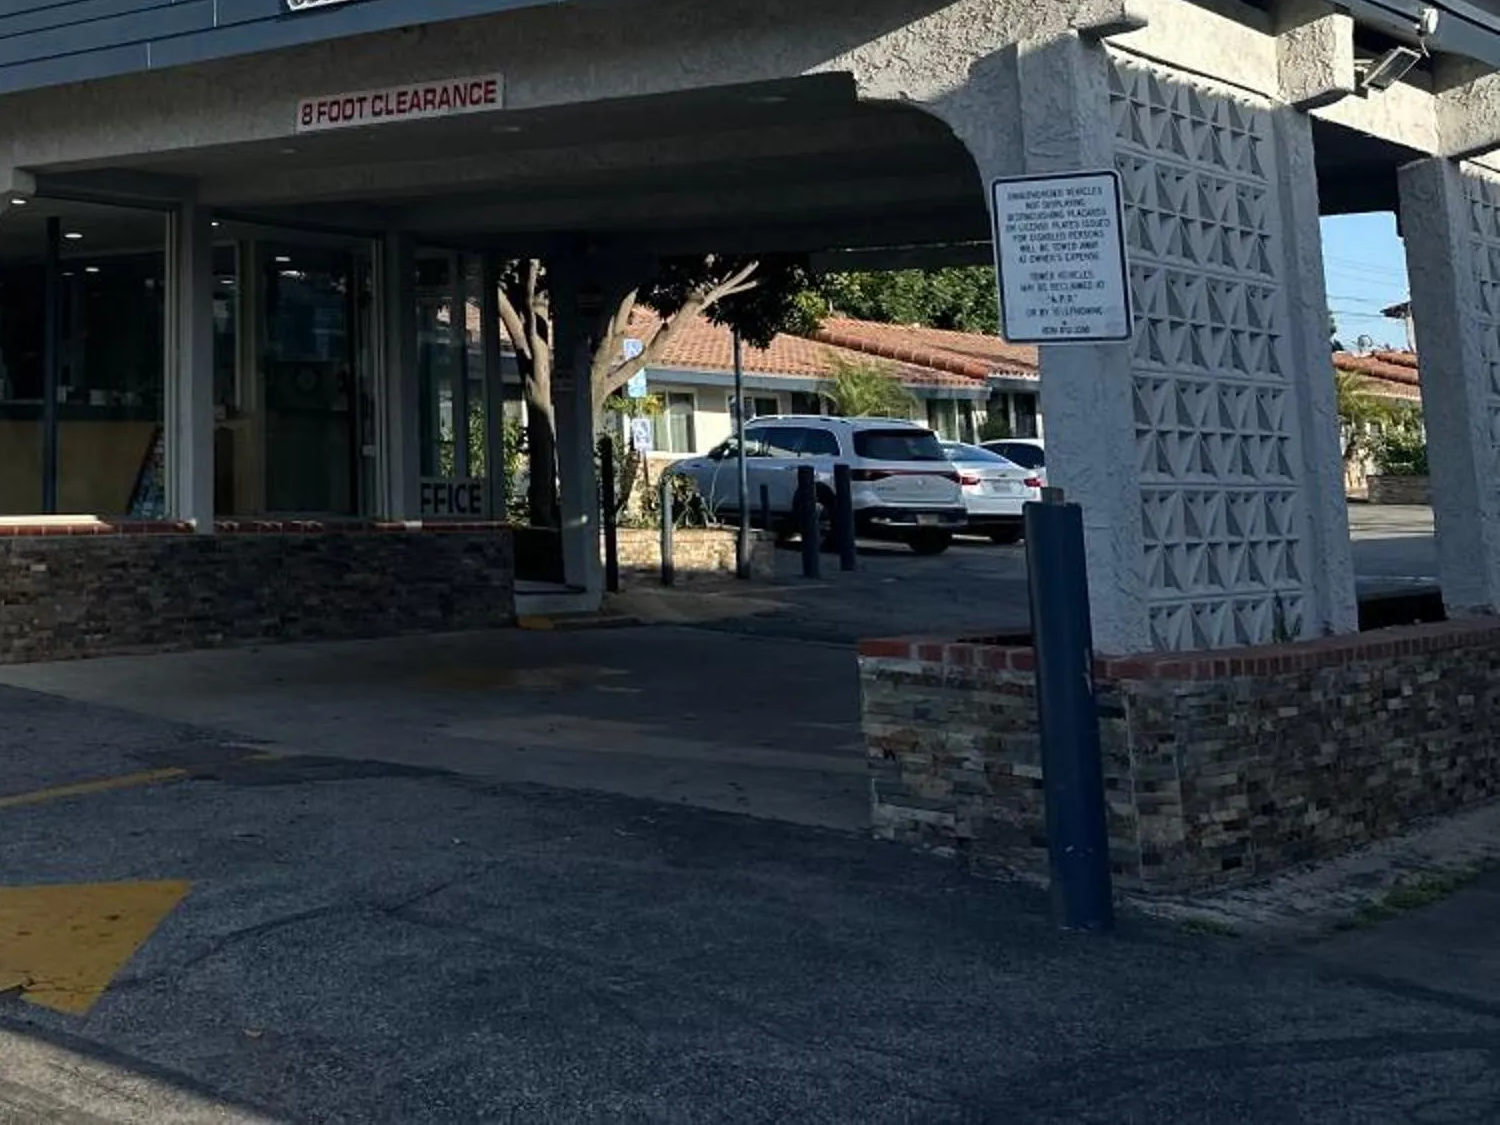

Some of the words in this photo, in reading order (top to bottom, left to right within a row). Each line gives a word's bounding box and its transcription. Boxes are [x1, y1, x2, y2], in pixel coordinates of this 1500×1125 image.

[301, 103, 313, 125] 8
[317, 96, 367, 123] FOOT
[371, 80, 498, 117] CLEARANCE
[420, 482, 481, 514] FFICE
